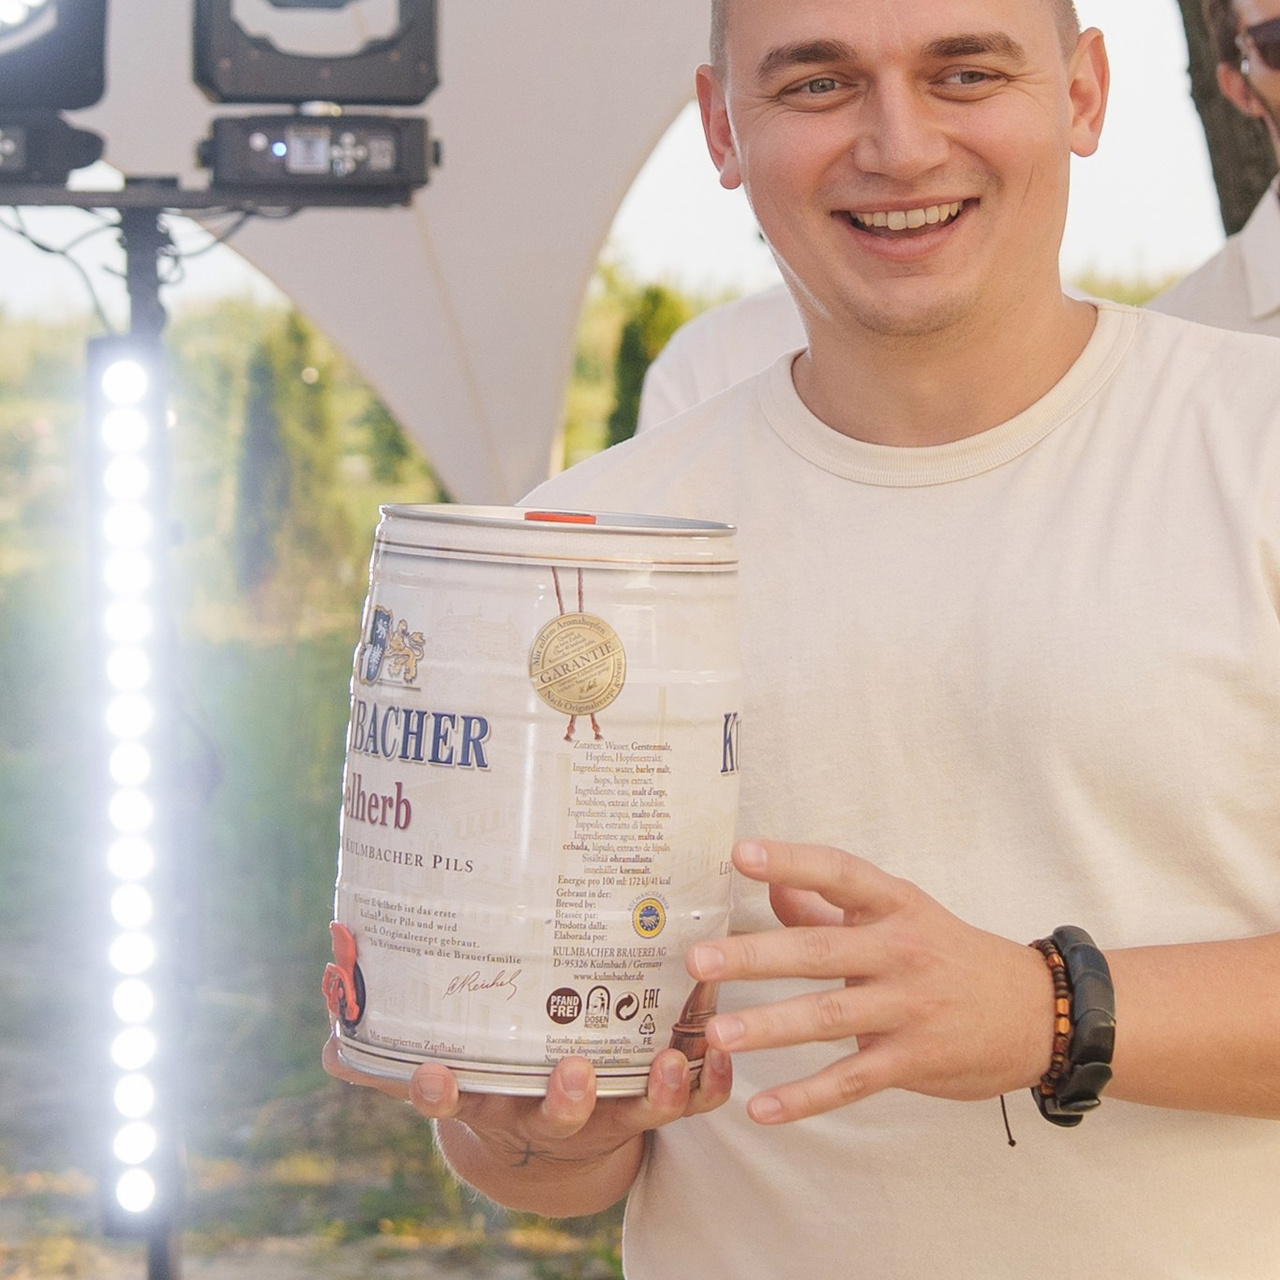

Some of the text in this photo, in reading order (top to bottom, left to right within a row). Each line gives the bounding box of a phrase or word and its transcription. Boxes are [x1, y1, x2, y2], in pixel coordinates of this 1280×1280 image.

[540, 642, 614, 683] GARANTIE
[545, 691, 563, 707] Nach
[351, 700, 488, 767] BACHER
[346, 837, 474, 873] KULMBACHER PILS
[558, 875, 586, 887] Energie
[588, 878, 600, 887] pro
[602, 877, 614, 885] 100
[557, 888, 587, 897] Gebraut
[597, 889, 611, 898] der:
[556, 899, 583, 908] Brewed
[405, 905, 414, 913] ist
[417, 906, 431, 915] das
[434, 910, 456, 918] erste
[400, 914, 414, 926] Pils
[417, 920, 433, 929] und
[437, 923, 457, 932] wird
[555, 920, 586, 930] Prodotta
[379, 926, 438, 944] Originalrezept
[440, 935, 480, 948] gebraut.
[554, 931, 591, 940] Elaborada
[437, 948, 450, 958] die
[454, 950, 521, 964] Brauerfamilie
[553, 946, 615, 957] KULMBACHER
[553, 959, 588, 968] D-95326
[590, 960, 626, 968] Kulmbach
[573, 972, 644, 981] www.kulmbacher.de
[550, 995, 579, 1006] PFAND
[550, 1006, 578, 1017] FREI
[643, 1037, 652, 1045] FE
[424, 1040, 465, 1055] Zapfhahn!
